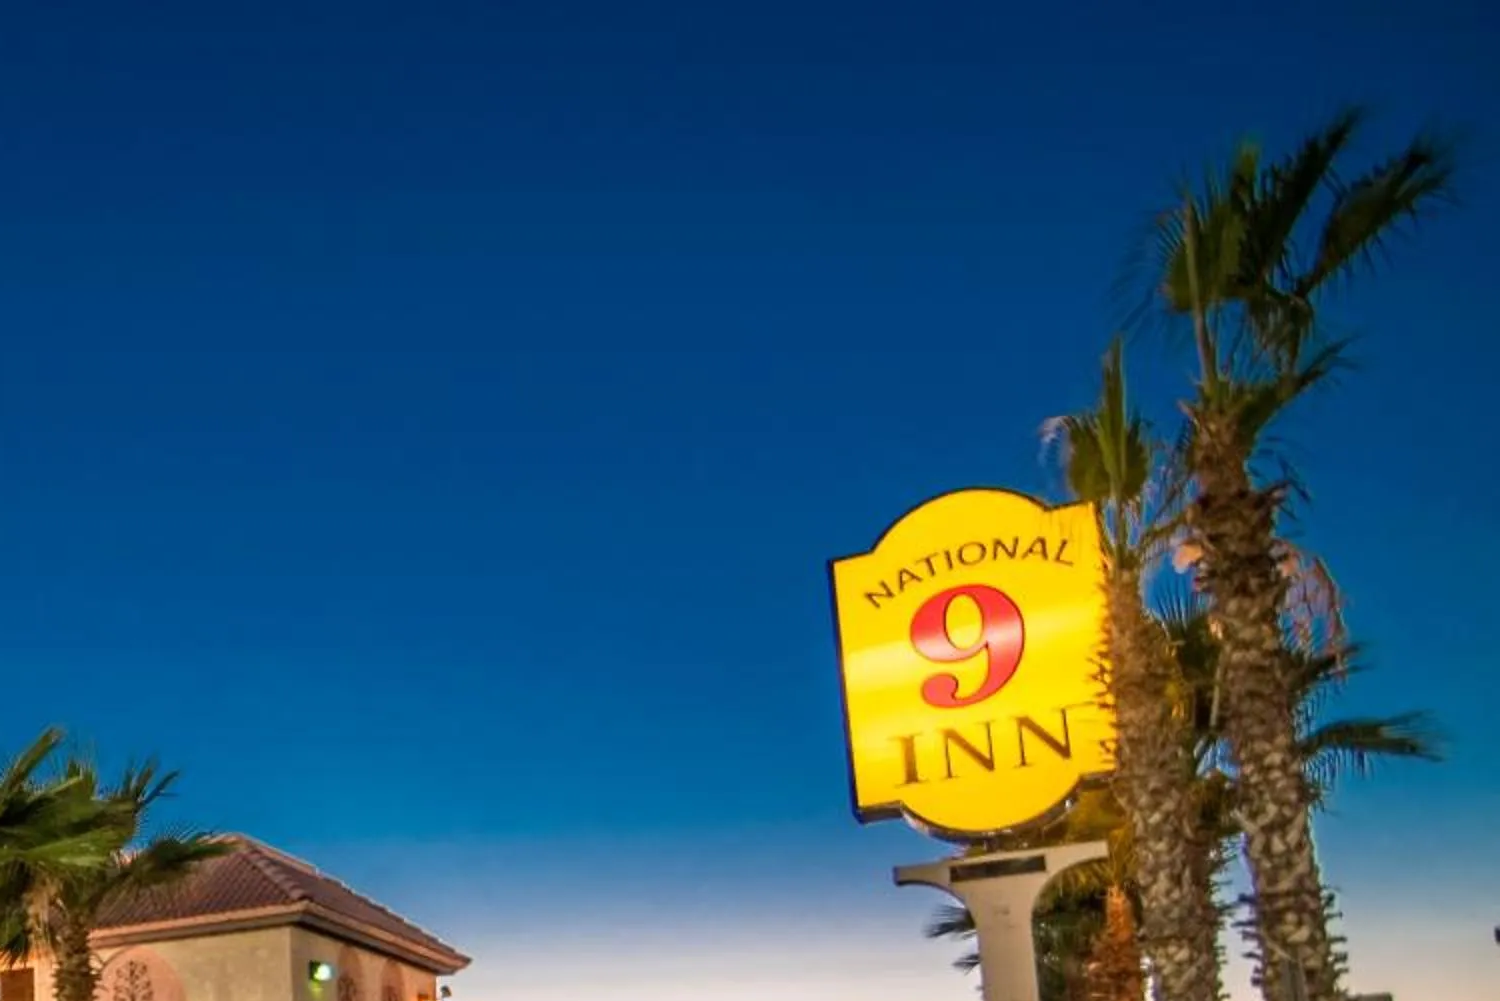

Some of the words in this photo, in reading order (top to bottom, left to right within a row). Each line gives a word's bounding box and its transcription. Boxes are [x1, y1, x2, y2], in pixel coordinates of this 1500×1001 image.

[864, 535, 1074, 609] NATIONAL
[909, 583, 1025, 709] 9
[891, 704, 1086, 788] INN
